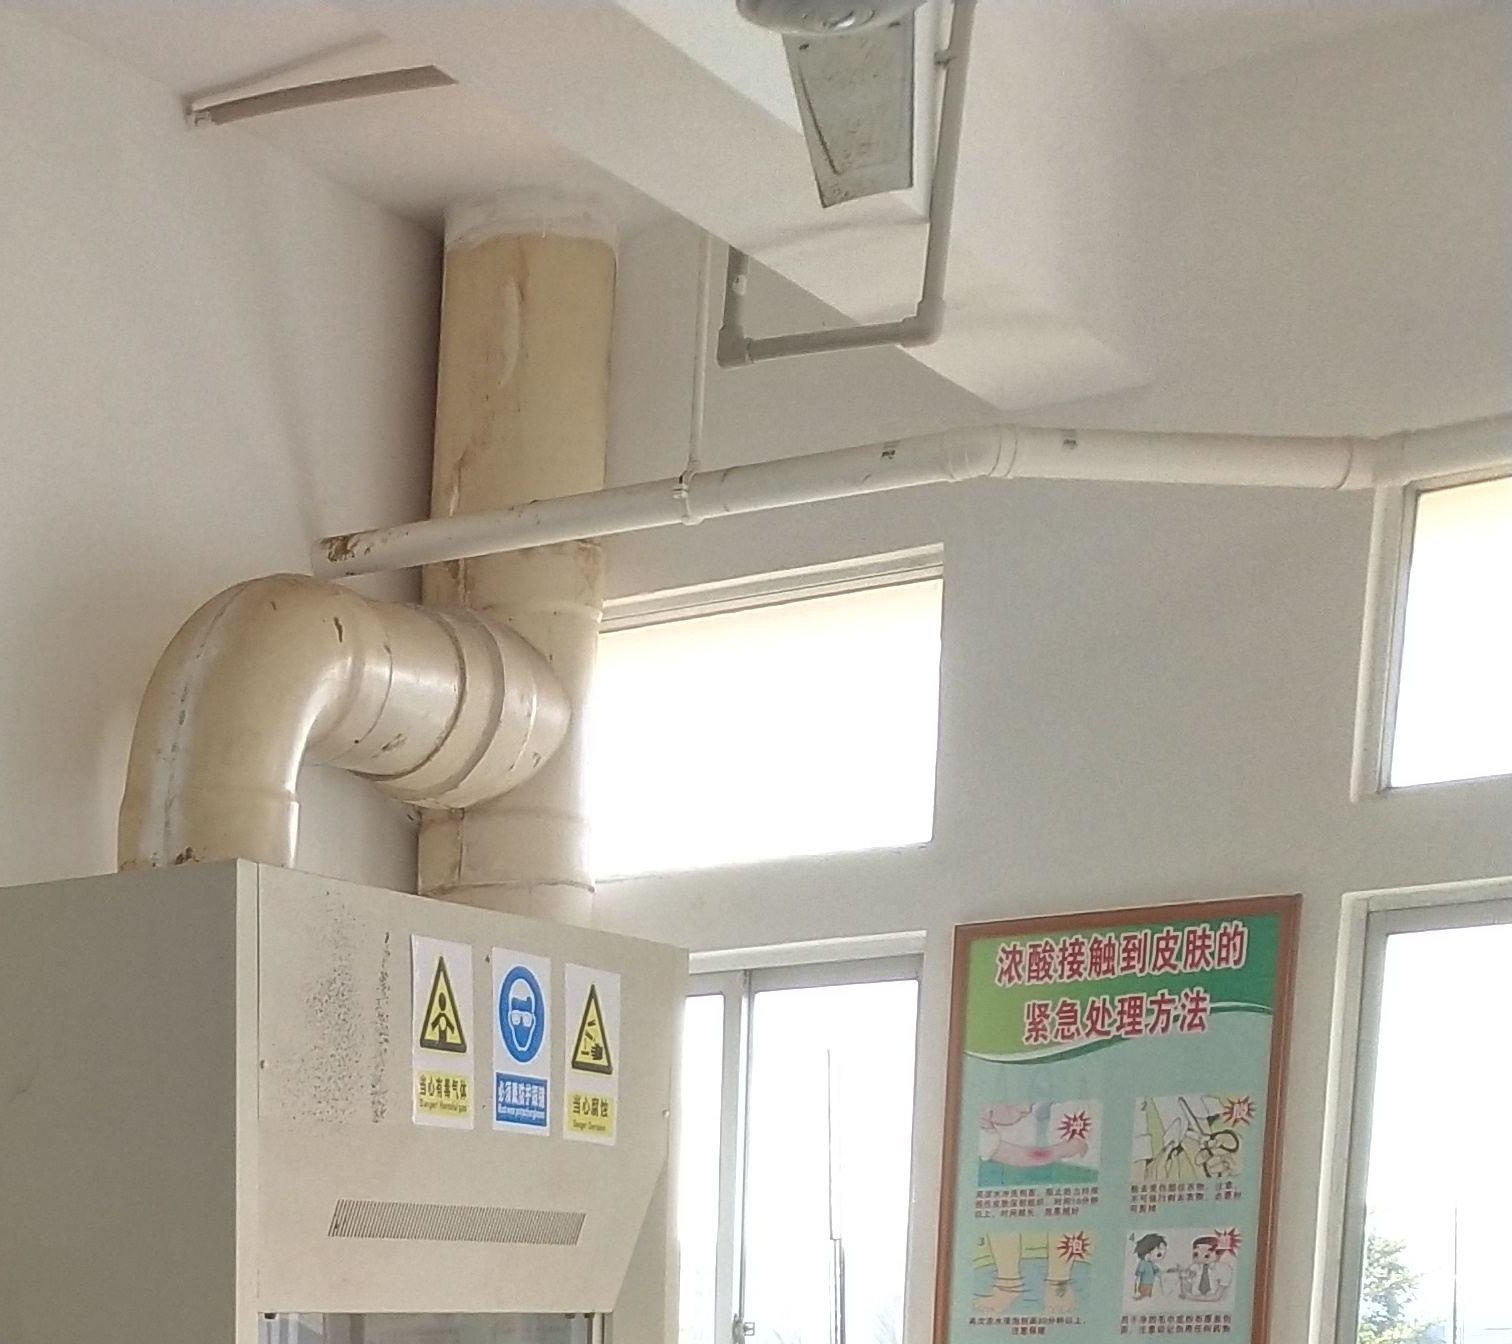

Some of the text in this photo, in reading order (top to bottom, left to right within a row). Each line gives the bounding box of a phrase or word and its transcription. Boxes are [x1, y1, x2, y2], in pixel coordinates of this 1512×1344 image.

[996, 922, 1248, 988] 浓酸接触到皮肤的
[1023, 990, 1210, 1045] 紧急处理方法
[1068, 1116, 1085, 1136] 冲
[1067, 1236, 1085, 1256] 泡
